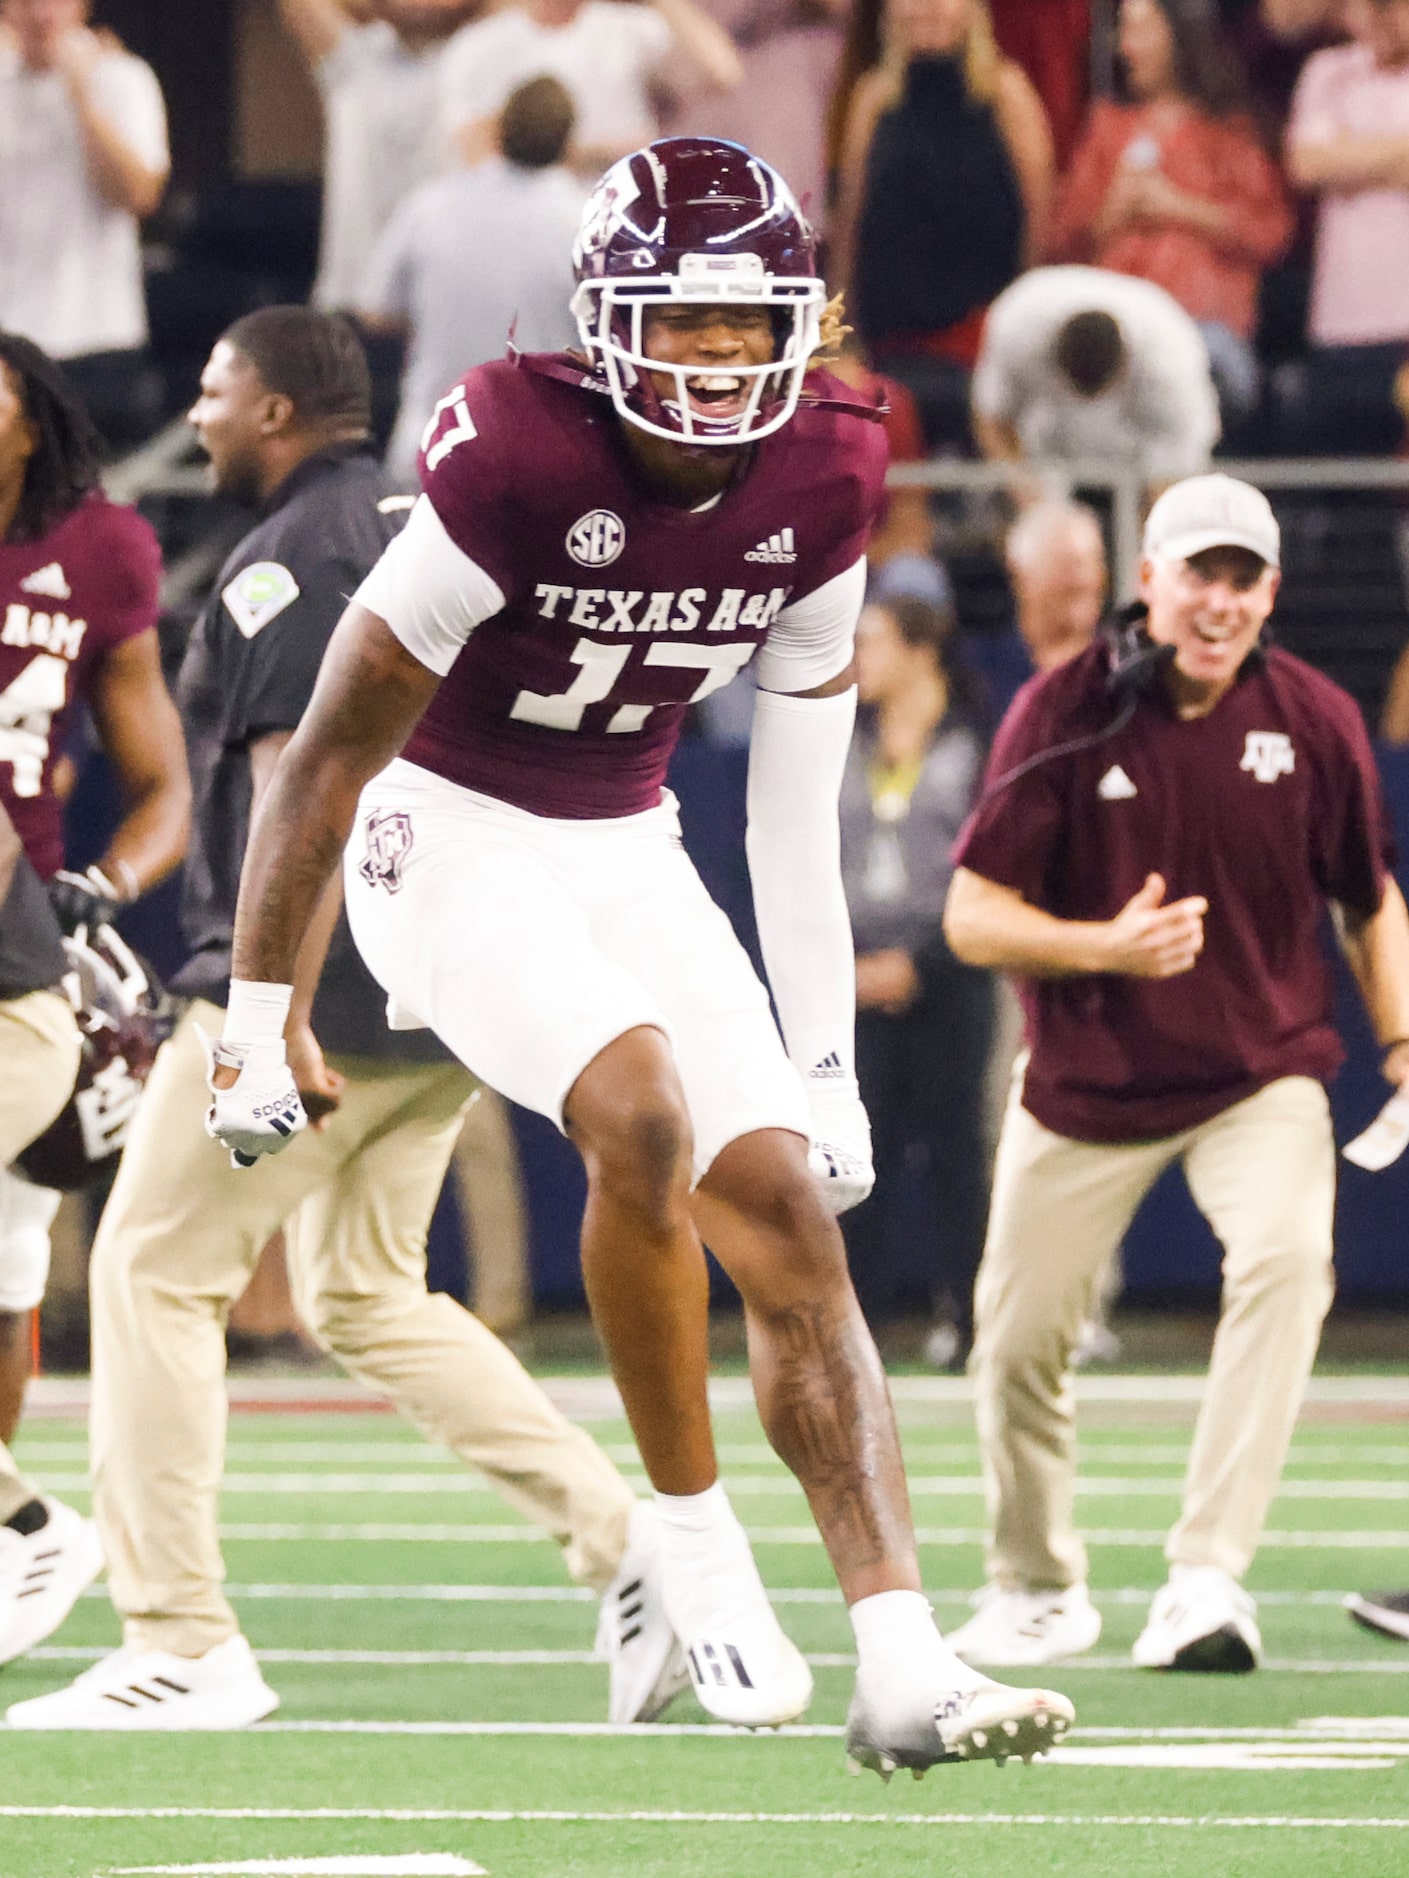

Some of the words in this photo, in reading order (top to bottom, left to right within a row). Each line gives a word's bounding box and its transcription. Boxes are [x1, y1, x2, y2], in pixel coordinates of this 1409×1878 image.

[571, 512, 621, 564] SEC
[0, 603, 88, 660] A&M
[534, 582, 708, 633] TEXAS
[508, 637, 758, 734] 17
